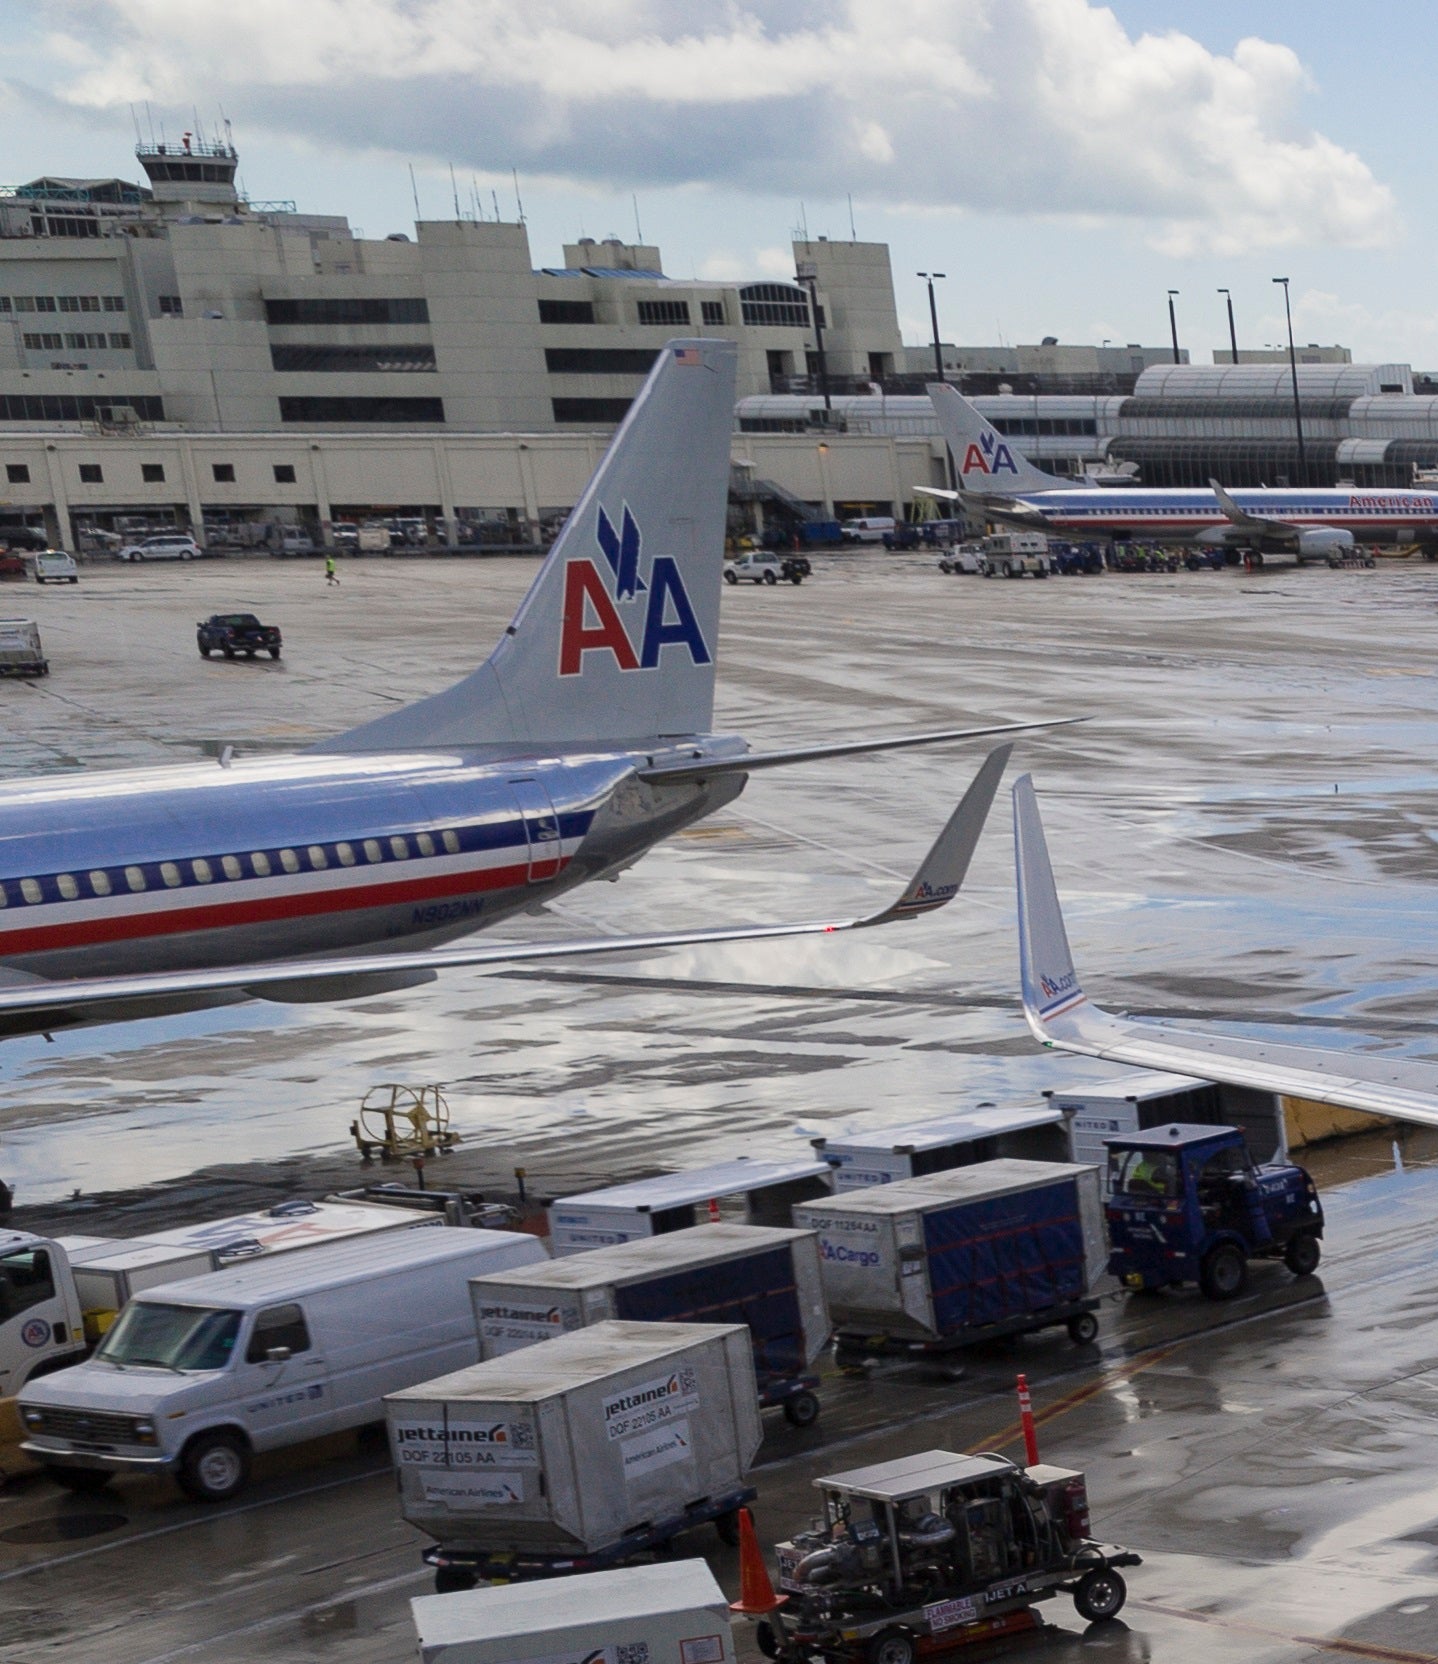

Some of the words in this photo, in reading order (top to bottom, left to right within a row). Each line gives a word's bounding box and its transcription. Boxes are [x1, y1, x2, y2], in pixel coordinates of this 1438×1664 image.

[962, 443, 1018, 474] AA
[1349, 496, 1434, 507] American
[558, 555, 713, 678] AA
[604, 1374, 678, 1421] jettainer
[398, 1424, 505, 1444] jettainer
[402, 1450, 430, 1462] DQF
[476, 1452, 496, 1464] AA
